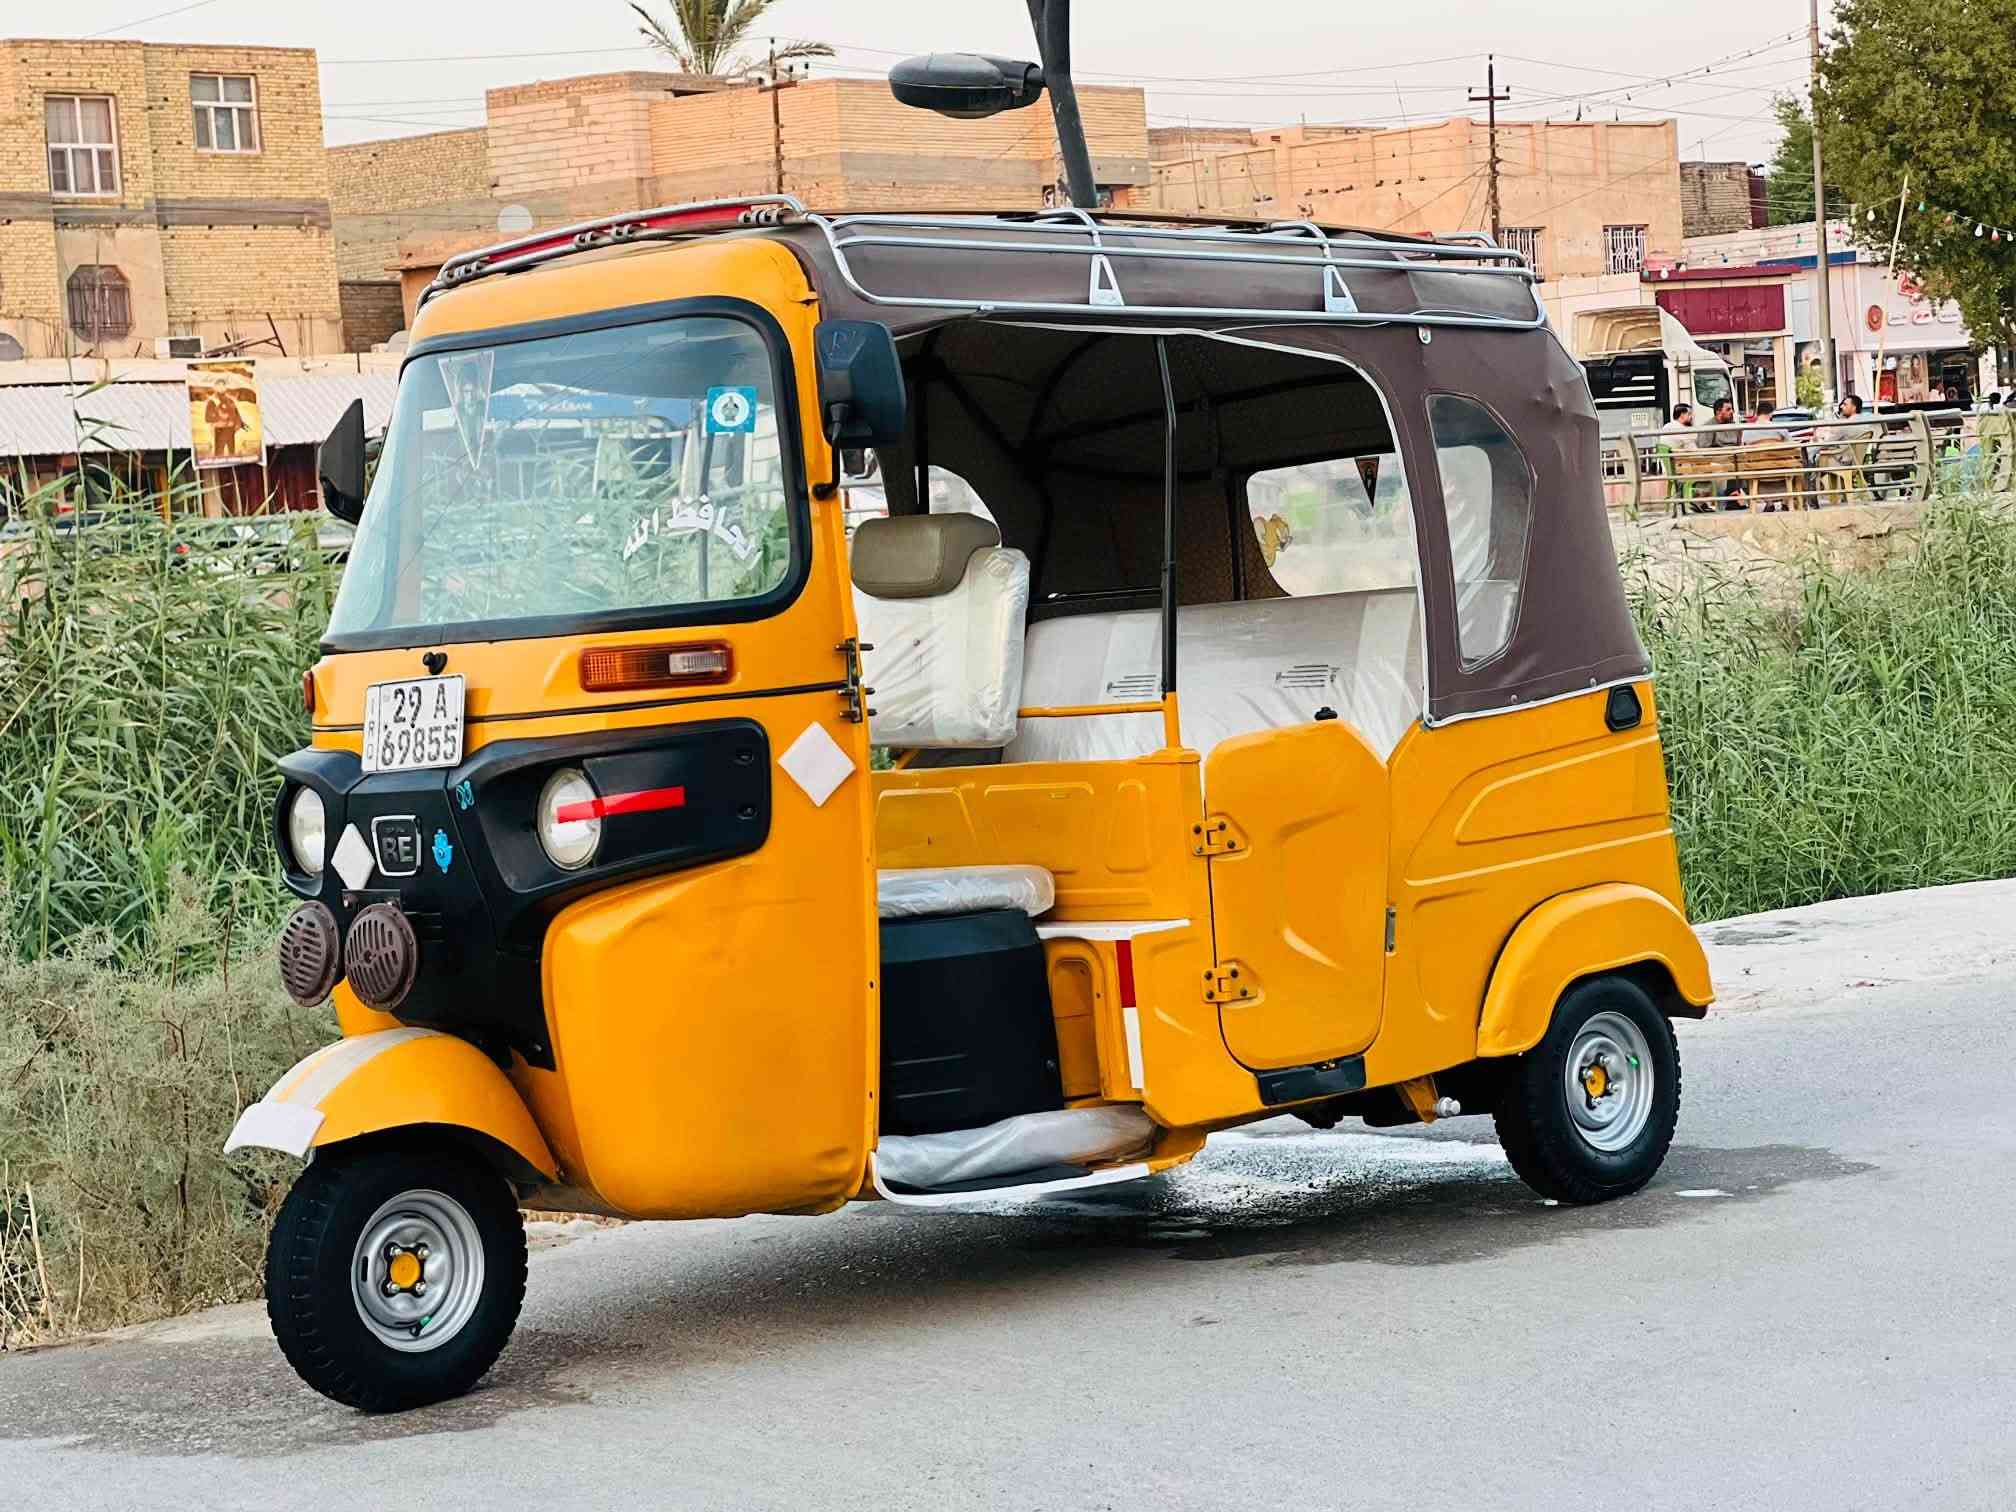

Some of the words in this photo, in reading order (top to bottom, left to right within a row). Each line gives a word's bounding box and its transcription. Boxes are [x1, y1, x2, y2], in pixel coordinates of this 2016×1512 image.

[393, 686, 422, 728] 29
[433, 683, 447, 719] A
[381, 724, 457, 766] 69855
[382, 836, 414, 863] RE
